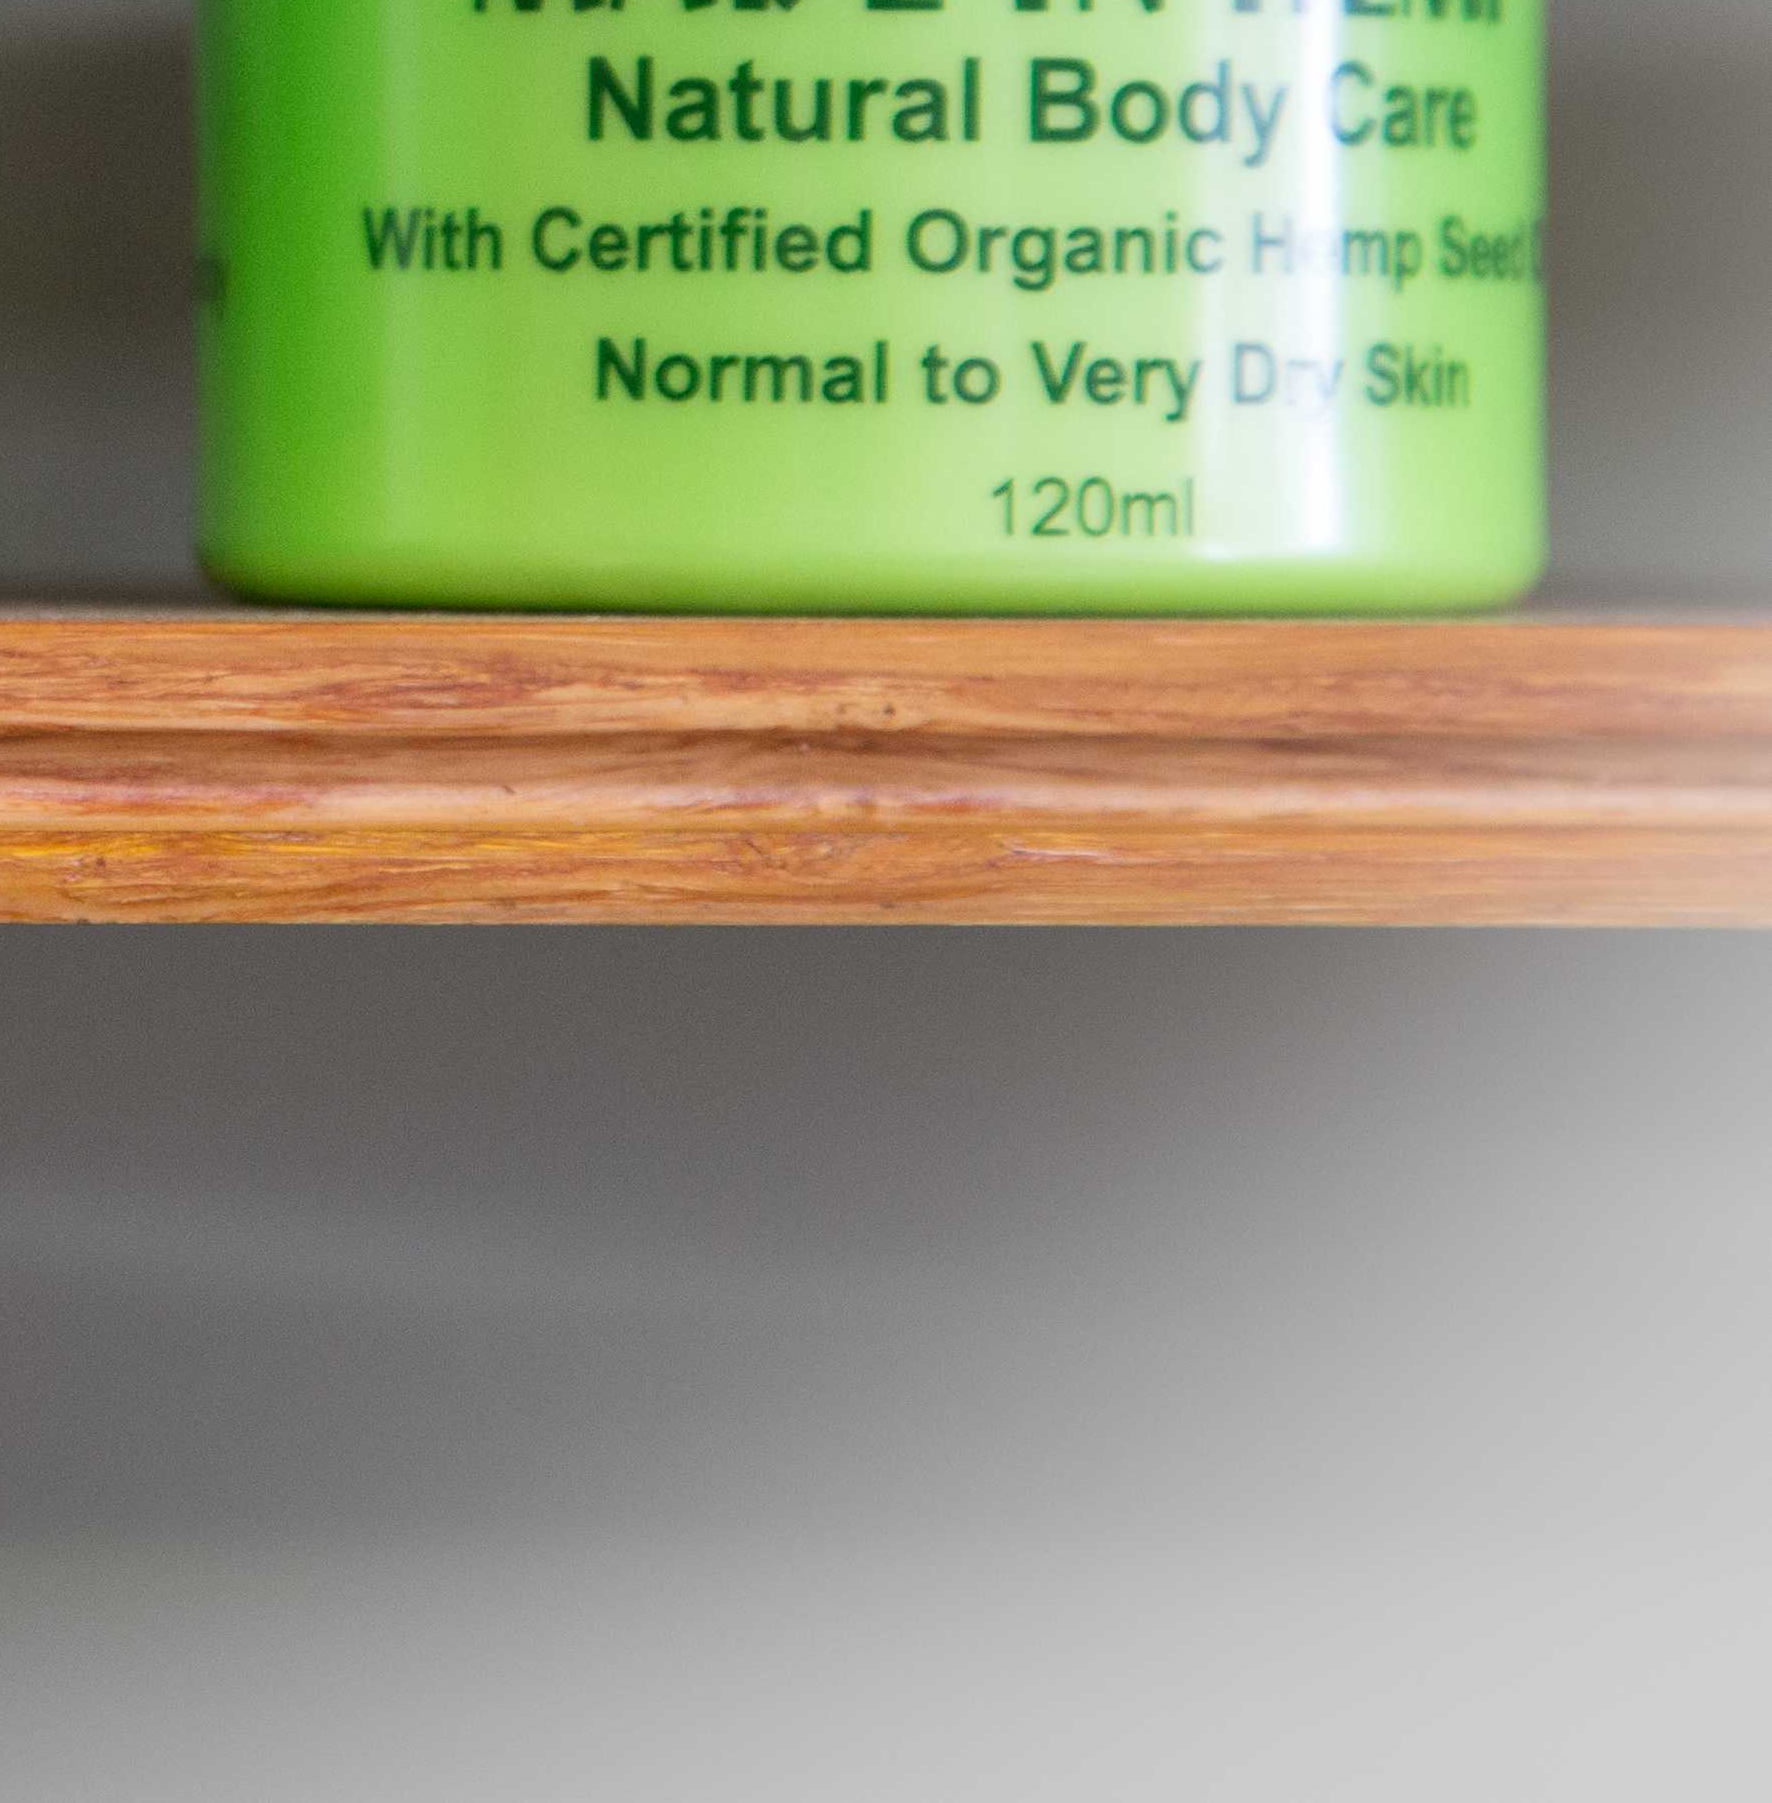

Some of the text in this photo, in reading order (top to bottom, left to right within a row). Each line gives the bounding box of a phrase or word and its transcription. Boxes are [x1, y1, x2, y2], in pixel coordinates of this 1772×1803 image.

[584, 53, 1477, 169] Natural Body Care
[360, 202, 503, 273] With
[529, 204, 873, 275] Certified
[902, 207, 1223, 294] Organic
[1250, 212, 1423, 292] Hmp
[592, 335, 889, 406] Normal
[917, 343, 1001, 407] to
[1026, 339, 1203, 425] Very
[1361, 340, 1469, 409] Skin
[990, 475, 1193, 538] 120ml
